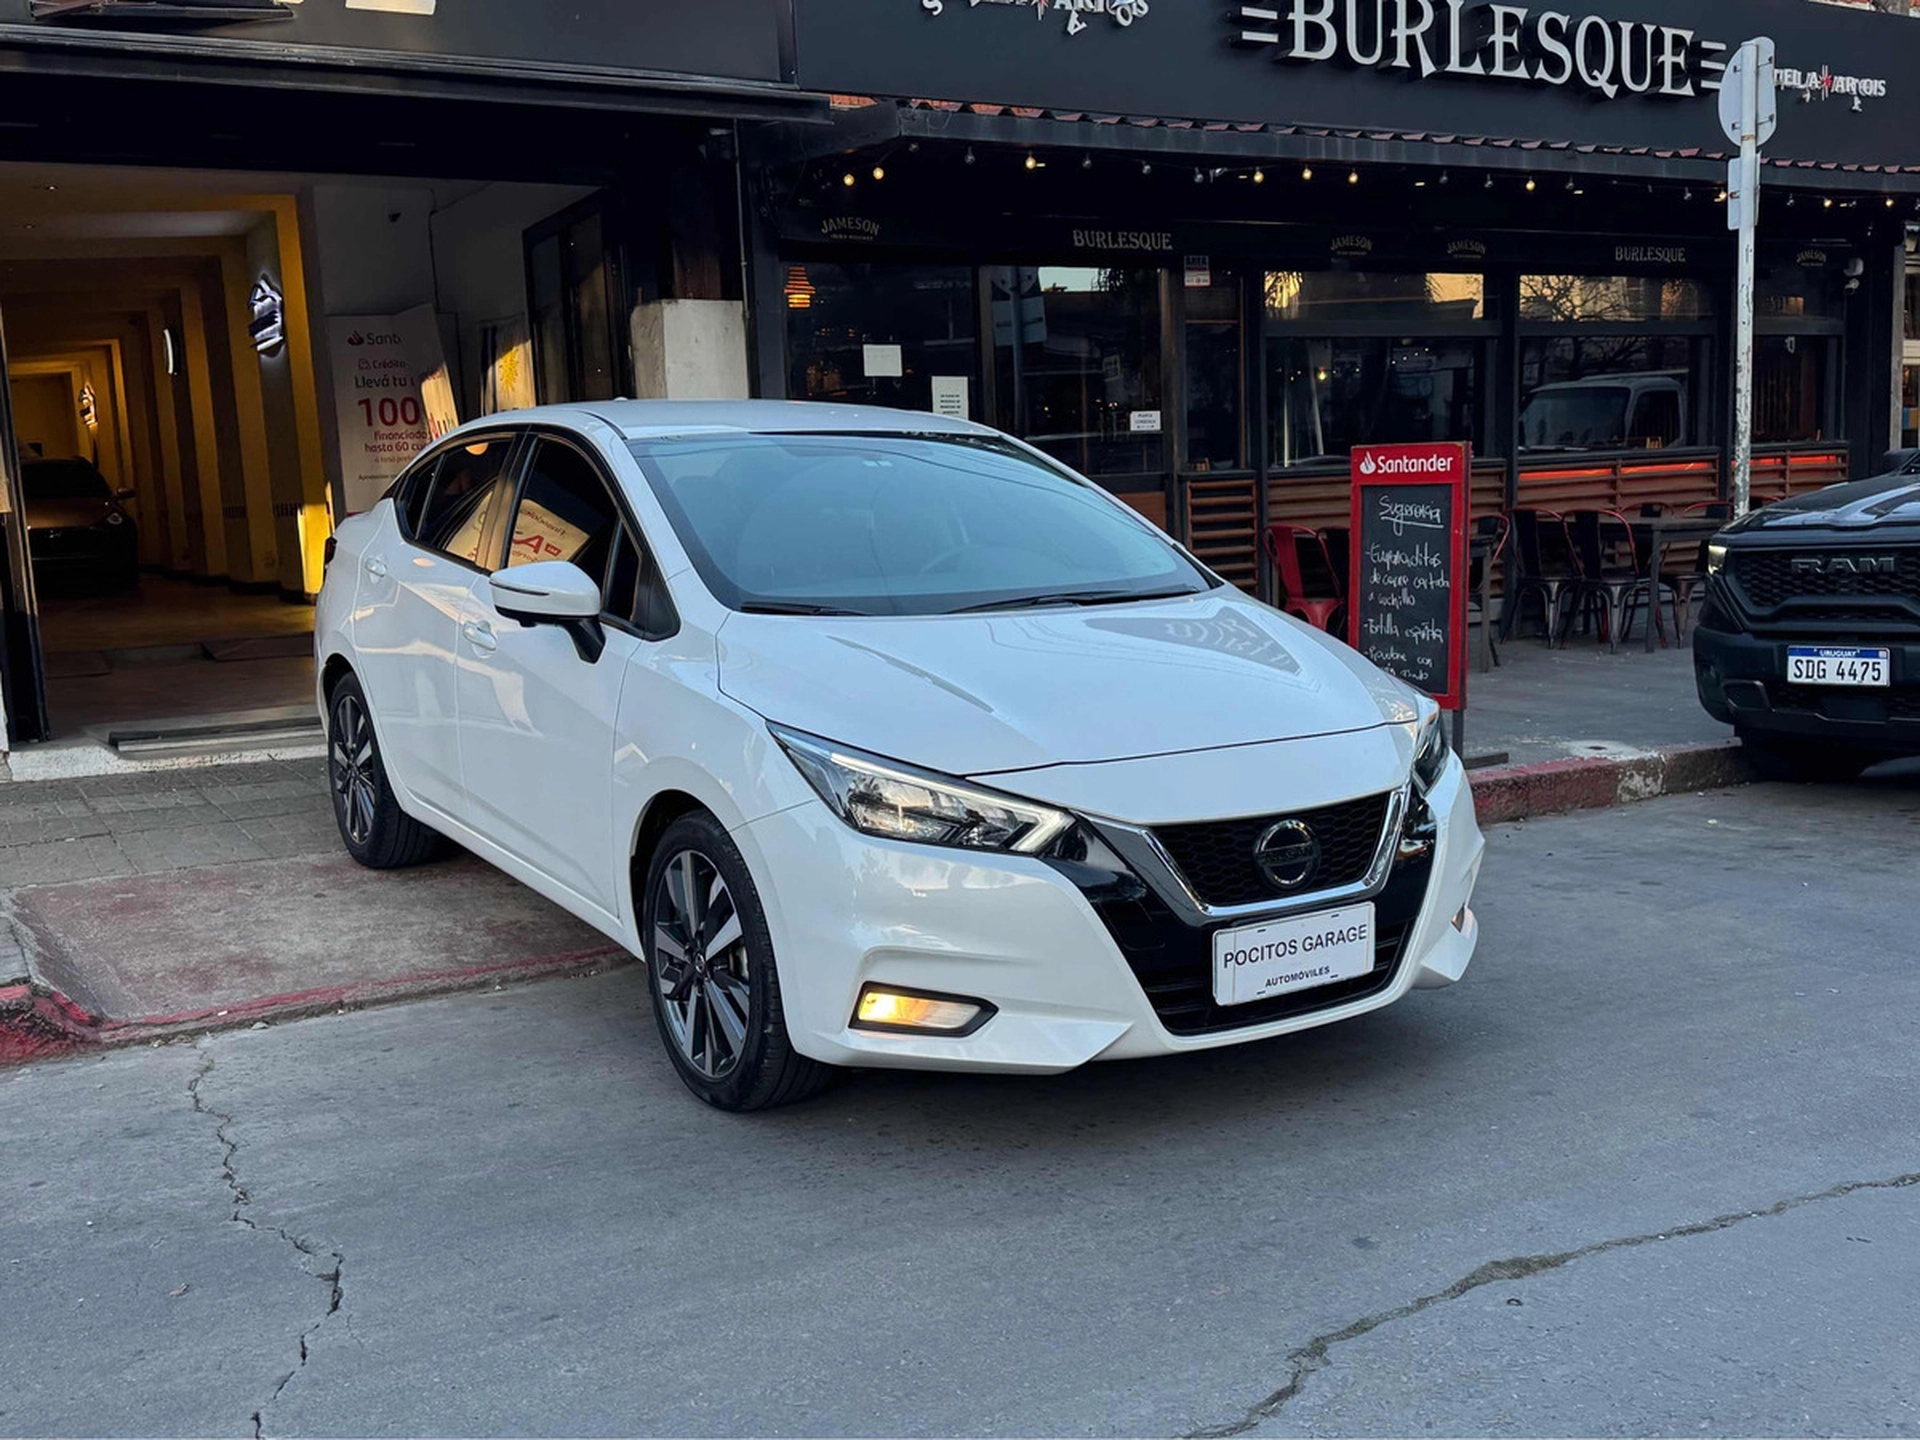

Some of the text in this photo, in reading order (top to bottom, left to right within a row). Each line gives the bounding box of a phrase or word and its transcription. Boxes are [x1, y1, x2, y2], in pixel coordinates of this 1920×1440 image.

[1287, 0, 1696, 98] BURLESQUE
[821, 217, 880, 236] JAMESON
[1073, 229, 1173, 251] BURLESQUE
[1331, 235, 1373, 250] JAMESON
[1447, 239, 1486, 254] JAMESON
[1615, 246, 1686, 263] BURLESQUE
[358, 397, 420, 428] 100
[395, 442, 409, 452] 60
[1377, 454, 1453, 474] Santander
[1791, 557, 1895, 574] RAM
[1369, 567, 1380, 584] de
[1819, 650, 1858, 659] URUGUAY
[1793, 659, 1882, 681] SDG 4475
[1223, 924, 1368, 969] POCITOS GARAGE
[1265, 965, 1331, 988] AUTOMÓVILES
